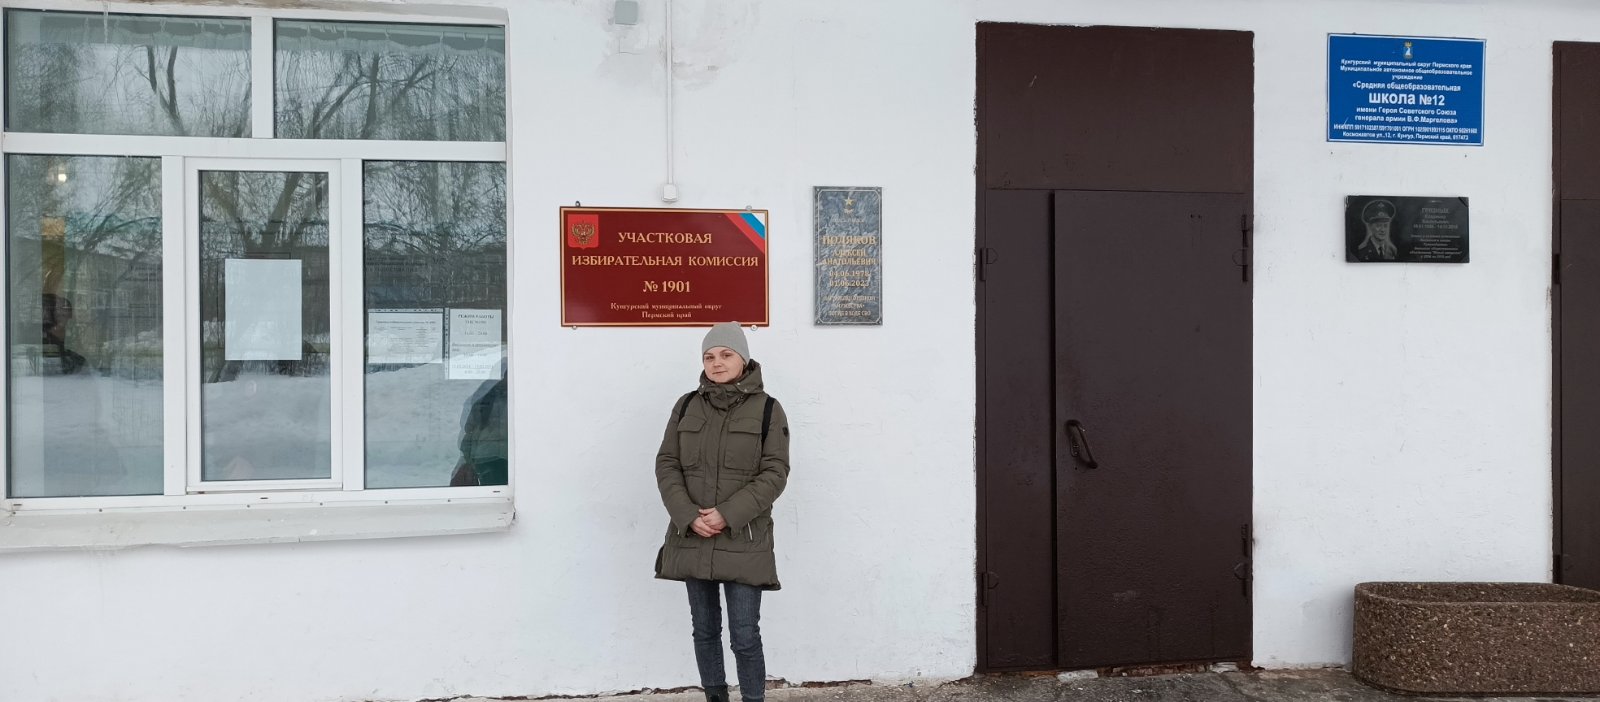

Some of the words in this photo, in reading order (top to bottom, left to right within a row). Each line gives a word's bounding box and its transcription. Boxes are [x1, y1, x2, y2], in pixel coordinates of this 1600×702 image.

[1353, 81, 1385, 90] «Средняя
[1387, 82, 1461, 92] общеобразовательная
[1419, 94, 1445, 106] №12
[618, 232, 712, 244] УЧАСТКОВАЯ
[822, 235, 877, 245] ПОЛЯКОВ
[571, 255, 682, 266] ИЗБИРАТЕЛЬНАЯ
[688, 256, 759, 267] КОМИССИЯ
[821, 257, 877, 265] АНАТОЛЬЕВИЧ
[642, 280, 659, 292] №
[662, 281, 691, 293] 1901
[610, 303, 649, 311] Кунгурский
[652, 303, 702, 311] муниципальный
[642, 311, 674, 319] Пермский
